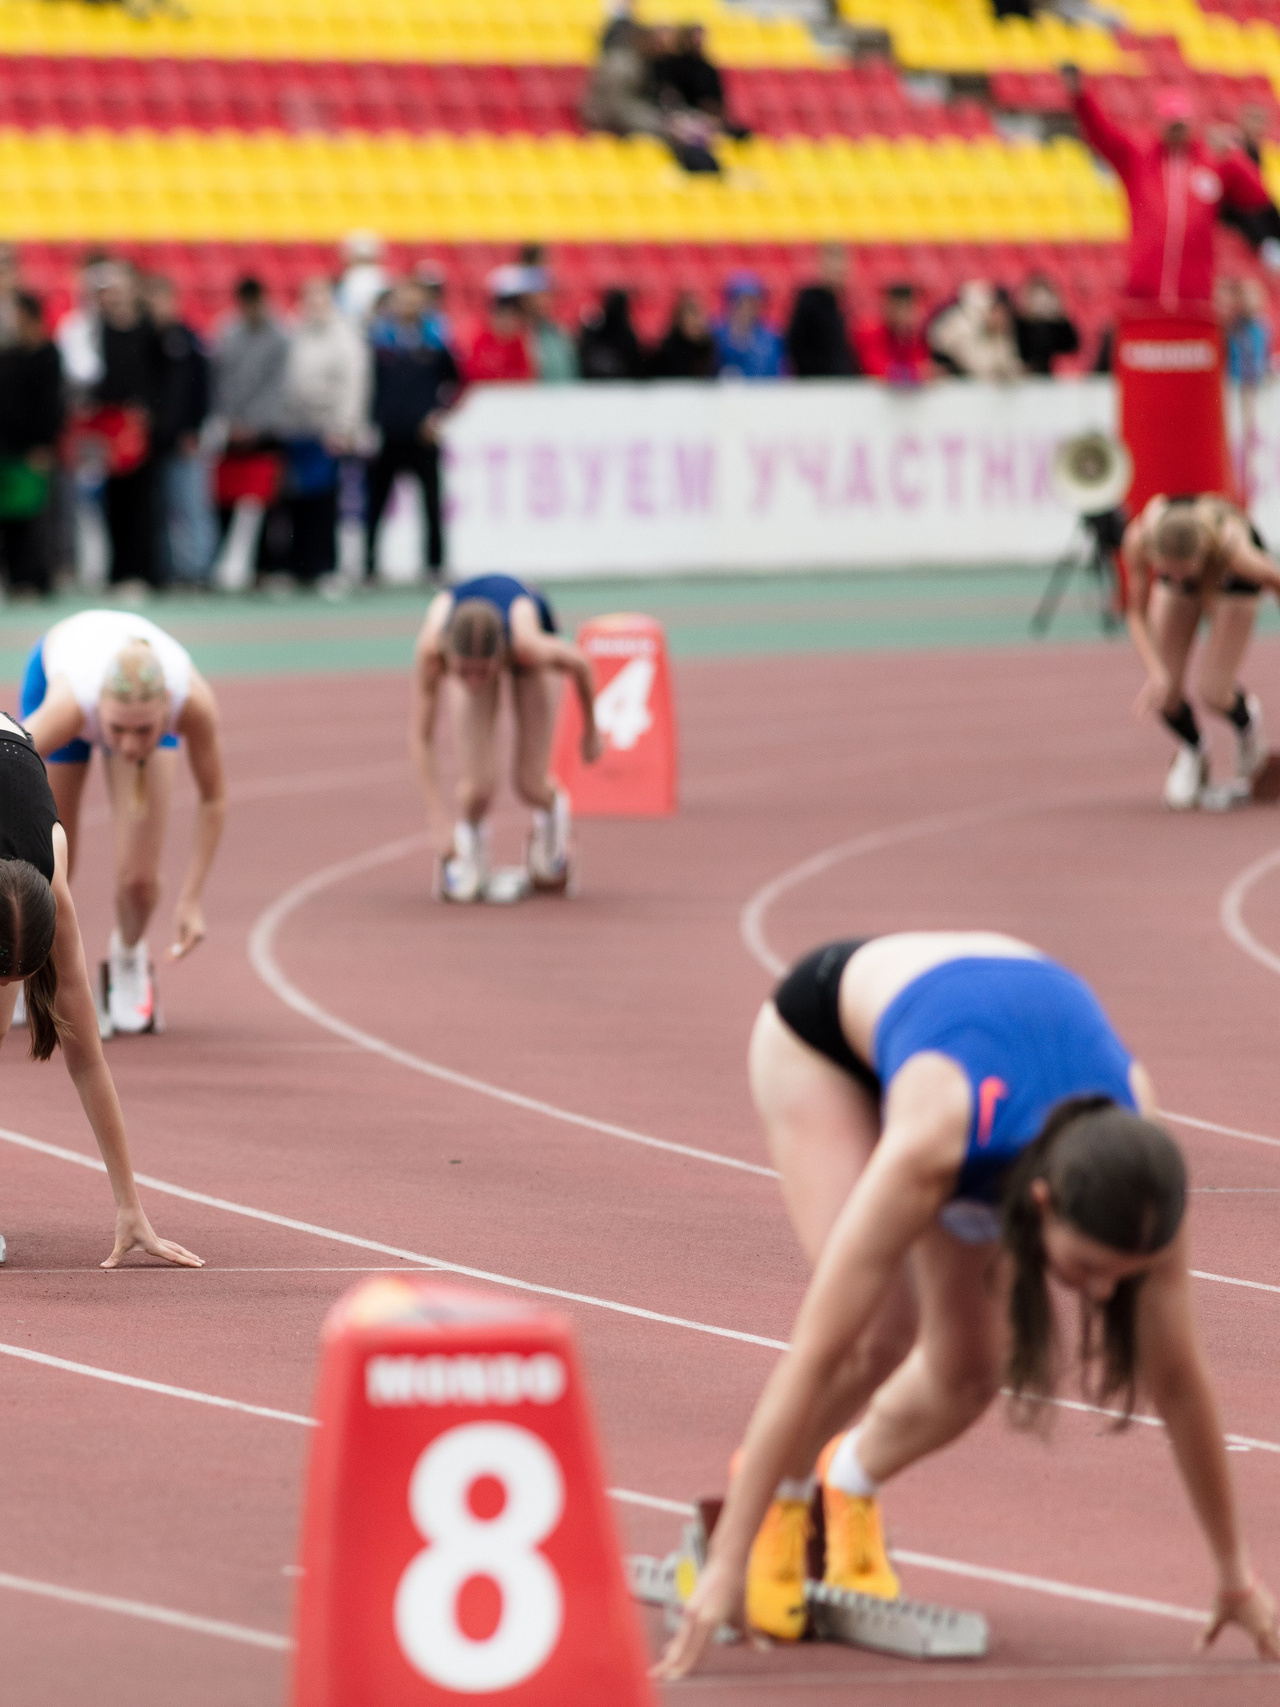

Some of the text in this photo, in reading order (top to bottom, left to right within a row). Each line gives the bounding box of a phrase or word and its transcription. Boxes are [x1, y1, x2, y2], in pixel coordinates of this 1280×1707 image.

[592, 656, 656, 750] 4
[366, 1353, 566, 1407] MONDO
[393, 1420, 566, 1694] 8
